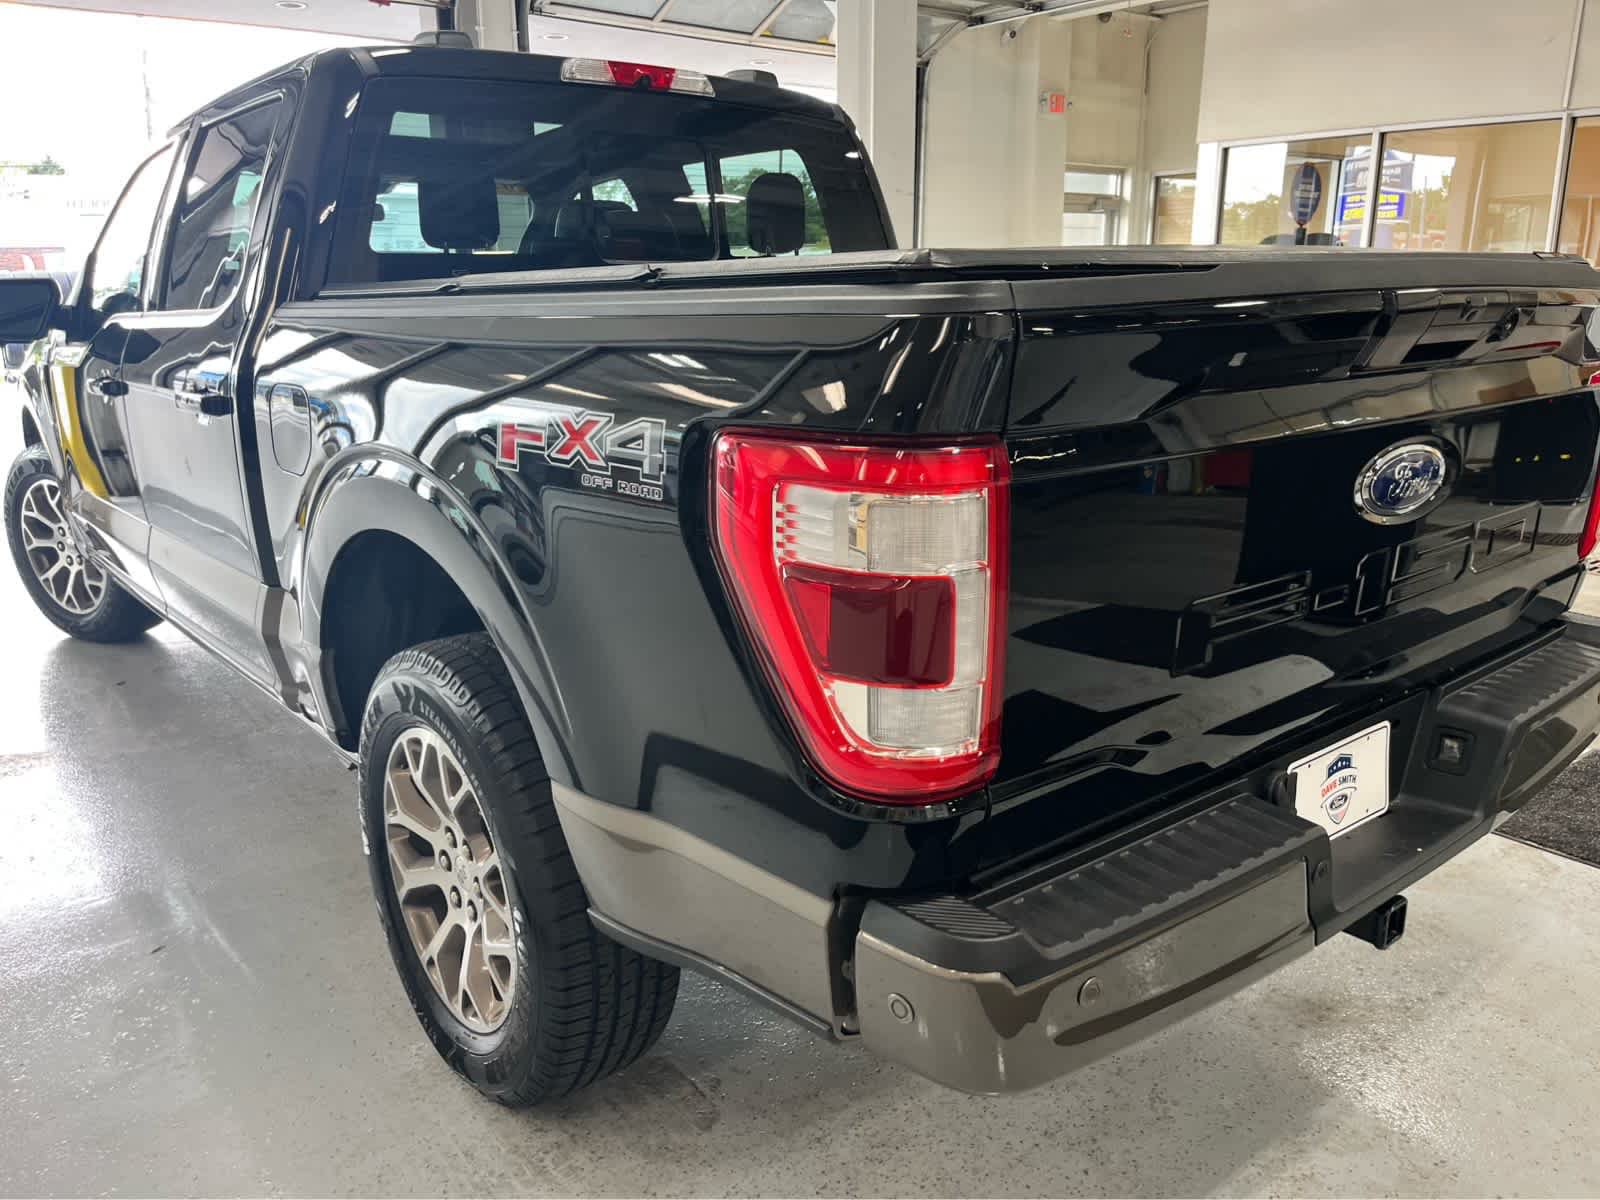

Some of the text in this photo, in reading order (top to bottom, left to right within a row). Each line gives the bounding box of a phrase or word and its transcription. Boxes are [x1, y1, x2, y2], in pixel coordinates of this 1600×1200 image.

[496, 410, 666, 484] FX4
[581, 473, 664, 500] OFF ROAD
[1386, 460, 1435, 503] Ford
[1169, 501, 1542, 678] F-150
[1338, 774, 1356, 785] SMITH
